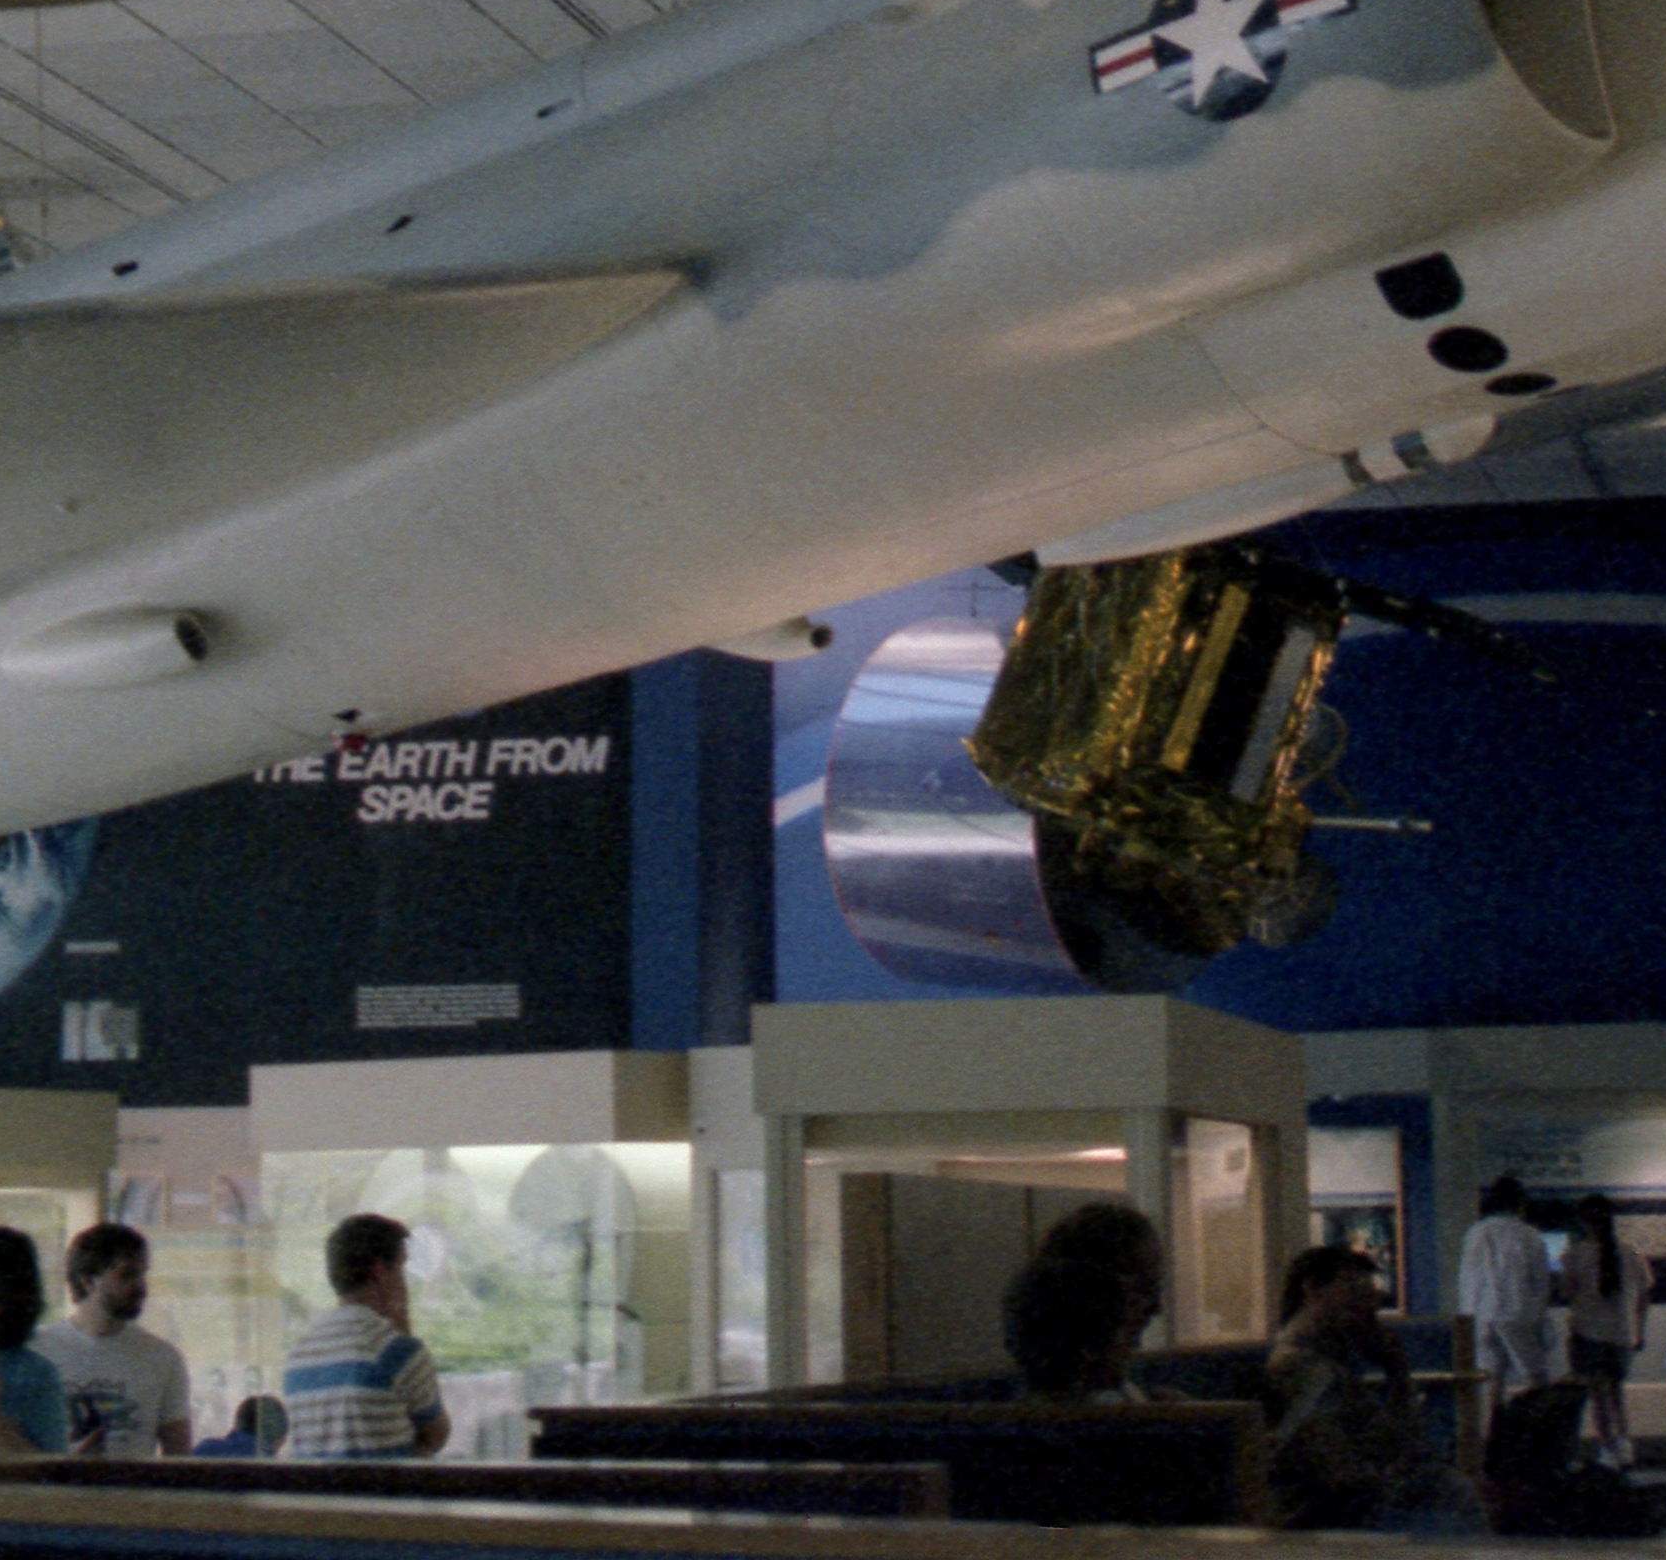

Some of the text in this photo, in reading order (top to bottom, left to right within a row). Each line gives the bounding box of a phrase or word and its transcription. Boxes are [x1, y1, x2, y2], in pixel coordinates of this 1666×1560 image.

[336, 739, 478, 782] EARTH
[485, 736, 611, 776] FROM
[356, 782, 496, 824] SPACE
